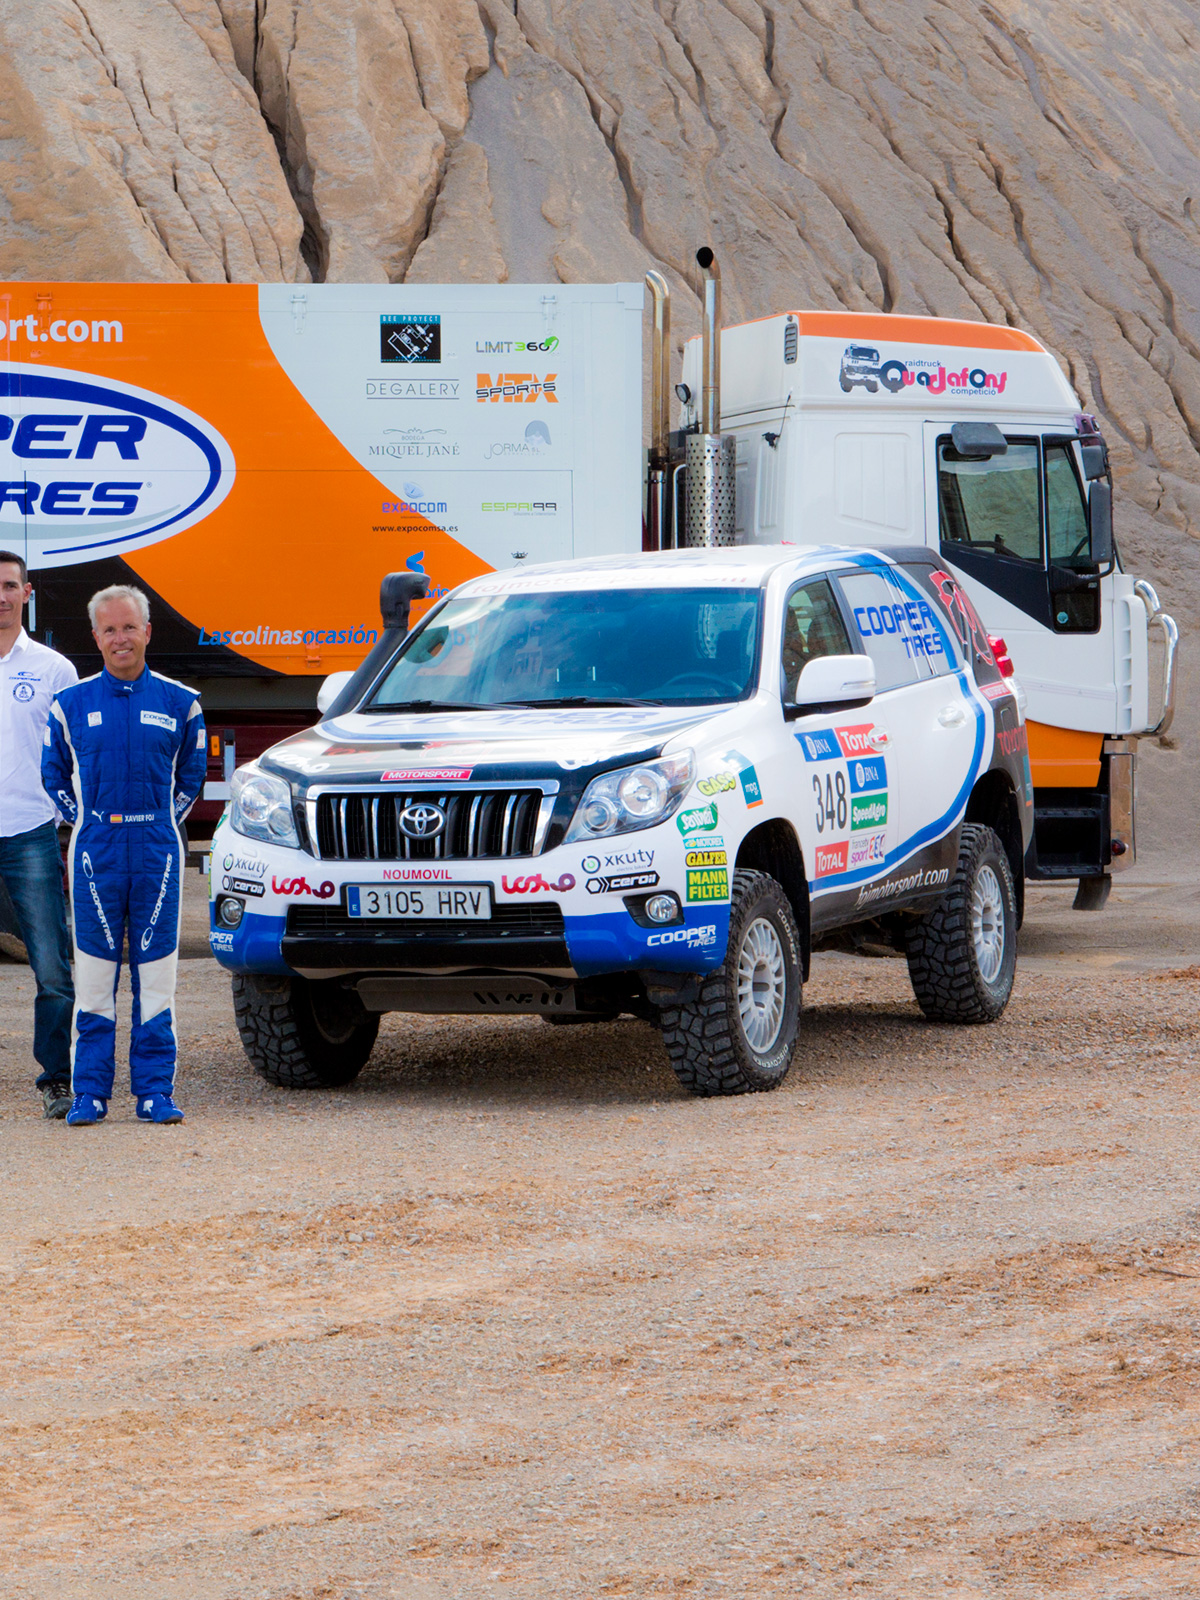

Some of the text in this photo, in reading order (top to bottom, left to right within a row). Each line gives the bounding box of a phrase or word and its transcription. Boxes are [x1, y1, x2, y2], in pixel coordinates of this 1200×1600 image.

[905, 360, 941, 368] raidtruck
[366, 383, 460, 395] DEGALERY
[476, 373, 559, 403] MTX
[476, 382, 556, 399] SPORTS
[369, 442, 460, 459] MIQUEL JANÉ
[372, 524, 459, 534] www.expocomsa.es
[853, 600, 936, 637] COOPER
[198, 624, 378, 646] Lascolinasocasión
[901, 632, 944, 659] TIRES
[813, 739, 832, 754] BNA
[388, 769, 465, 779] MOTORSPORT
[864, 766, 879, 782] BNA
[696, 771, 737, 797] GASS
[812, 771, 848, 833] 348
[852, 802, 886, 825] SpeedAgro
[604, 849, 655, 868] xkuty
[685, 851, 728, 868] GALFER
[817, 851, 844, 872] TOTAL
[851, 846, 869, 867] sport
[234, 855, 270, 878] xkuty
[383, 869, 453, 880] NOUMOVIL
[610, 873, 657, 888] ceroil
[688, 870, 727, 886] MANN
[689, 884, 729, 900] FILTER
[853, 868, 949, 910] fojmotorsport.com
[367, 891, 424, 914] 3105
[438, 891, 481, 915] HRV
[647, 924, 716, 946] COOPER
[687, 935, 717, 948] TIRES
[776, 908, 798, 966] COOPER
[213, 941, 234, 952] TIRES
